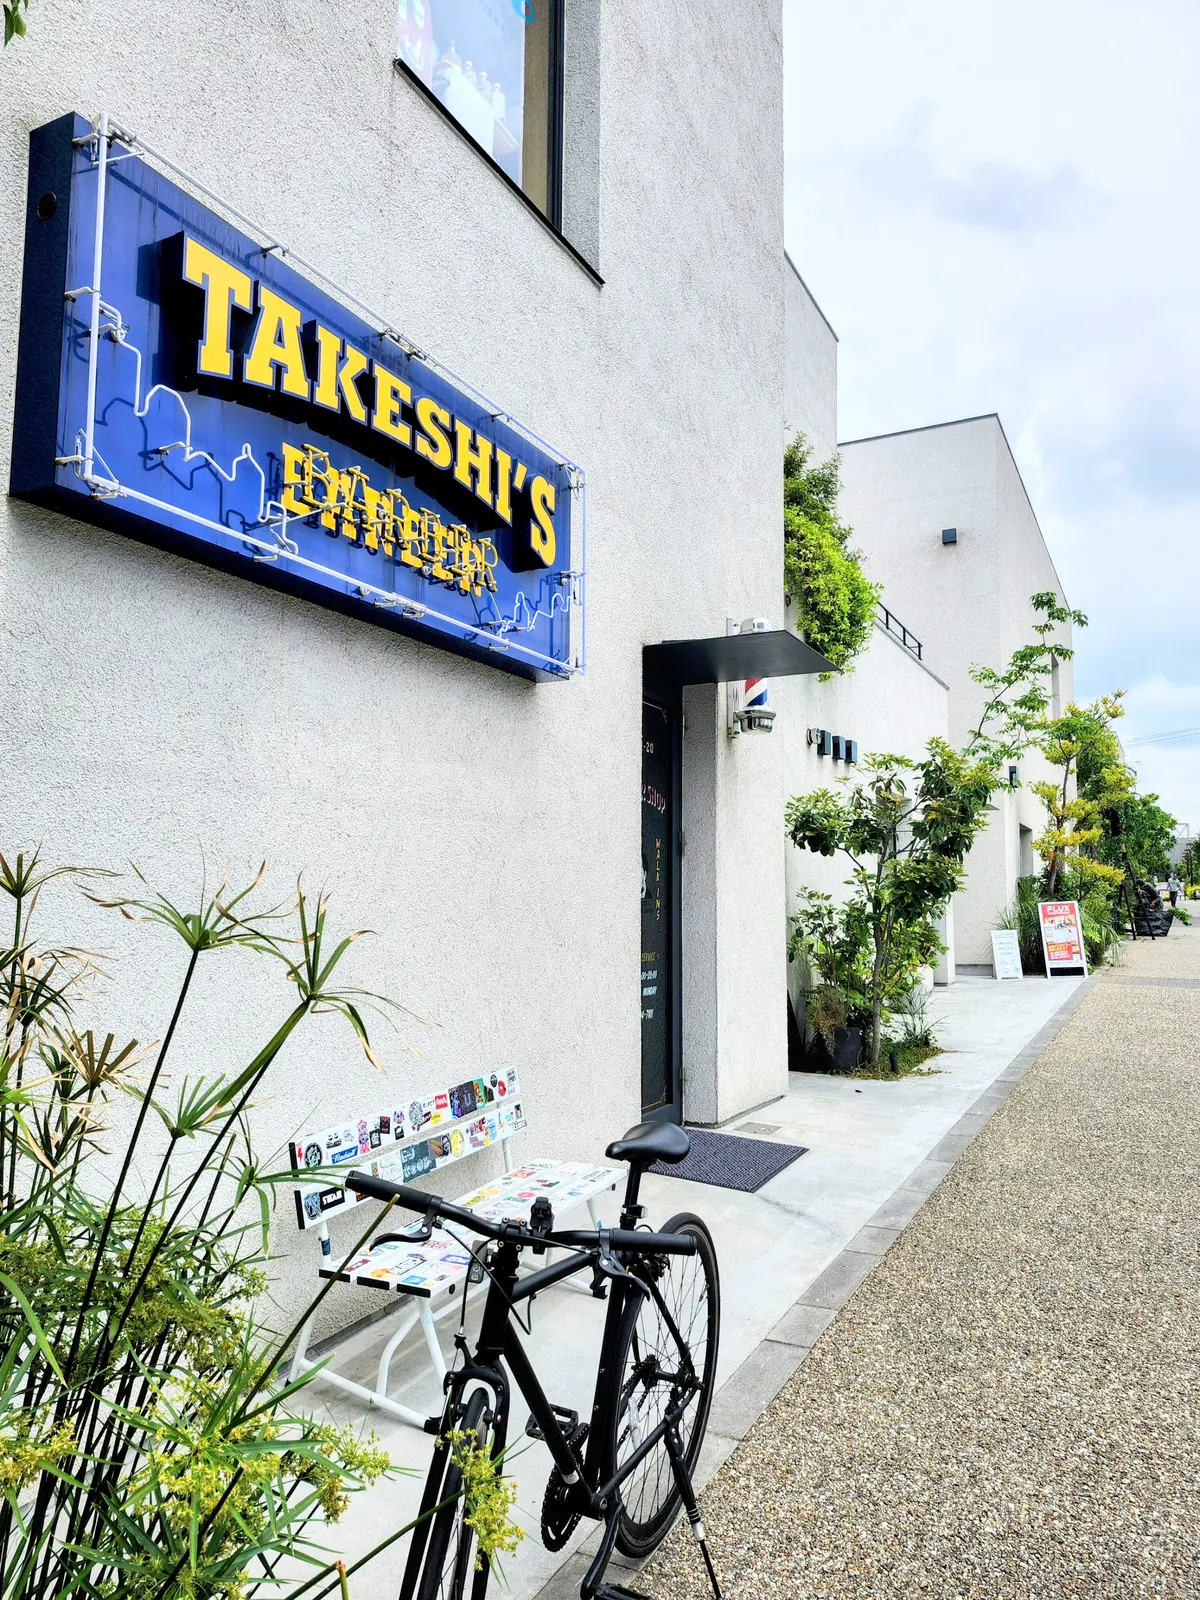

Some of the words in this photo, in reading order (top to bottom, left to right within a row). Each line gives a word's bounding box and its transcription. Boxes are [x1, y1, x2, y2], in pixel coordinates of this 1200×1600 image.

[183, 236, 557, 567] TAKESHI'S
[647, 785, 666, 814] SHOP
[1046, 904, 1070, 912] FLUX
